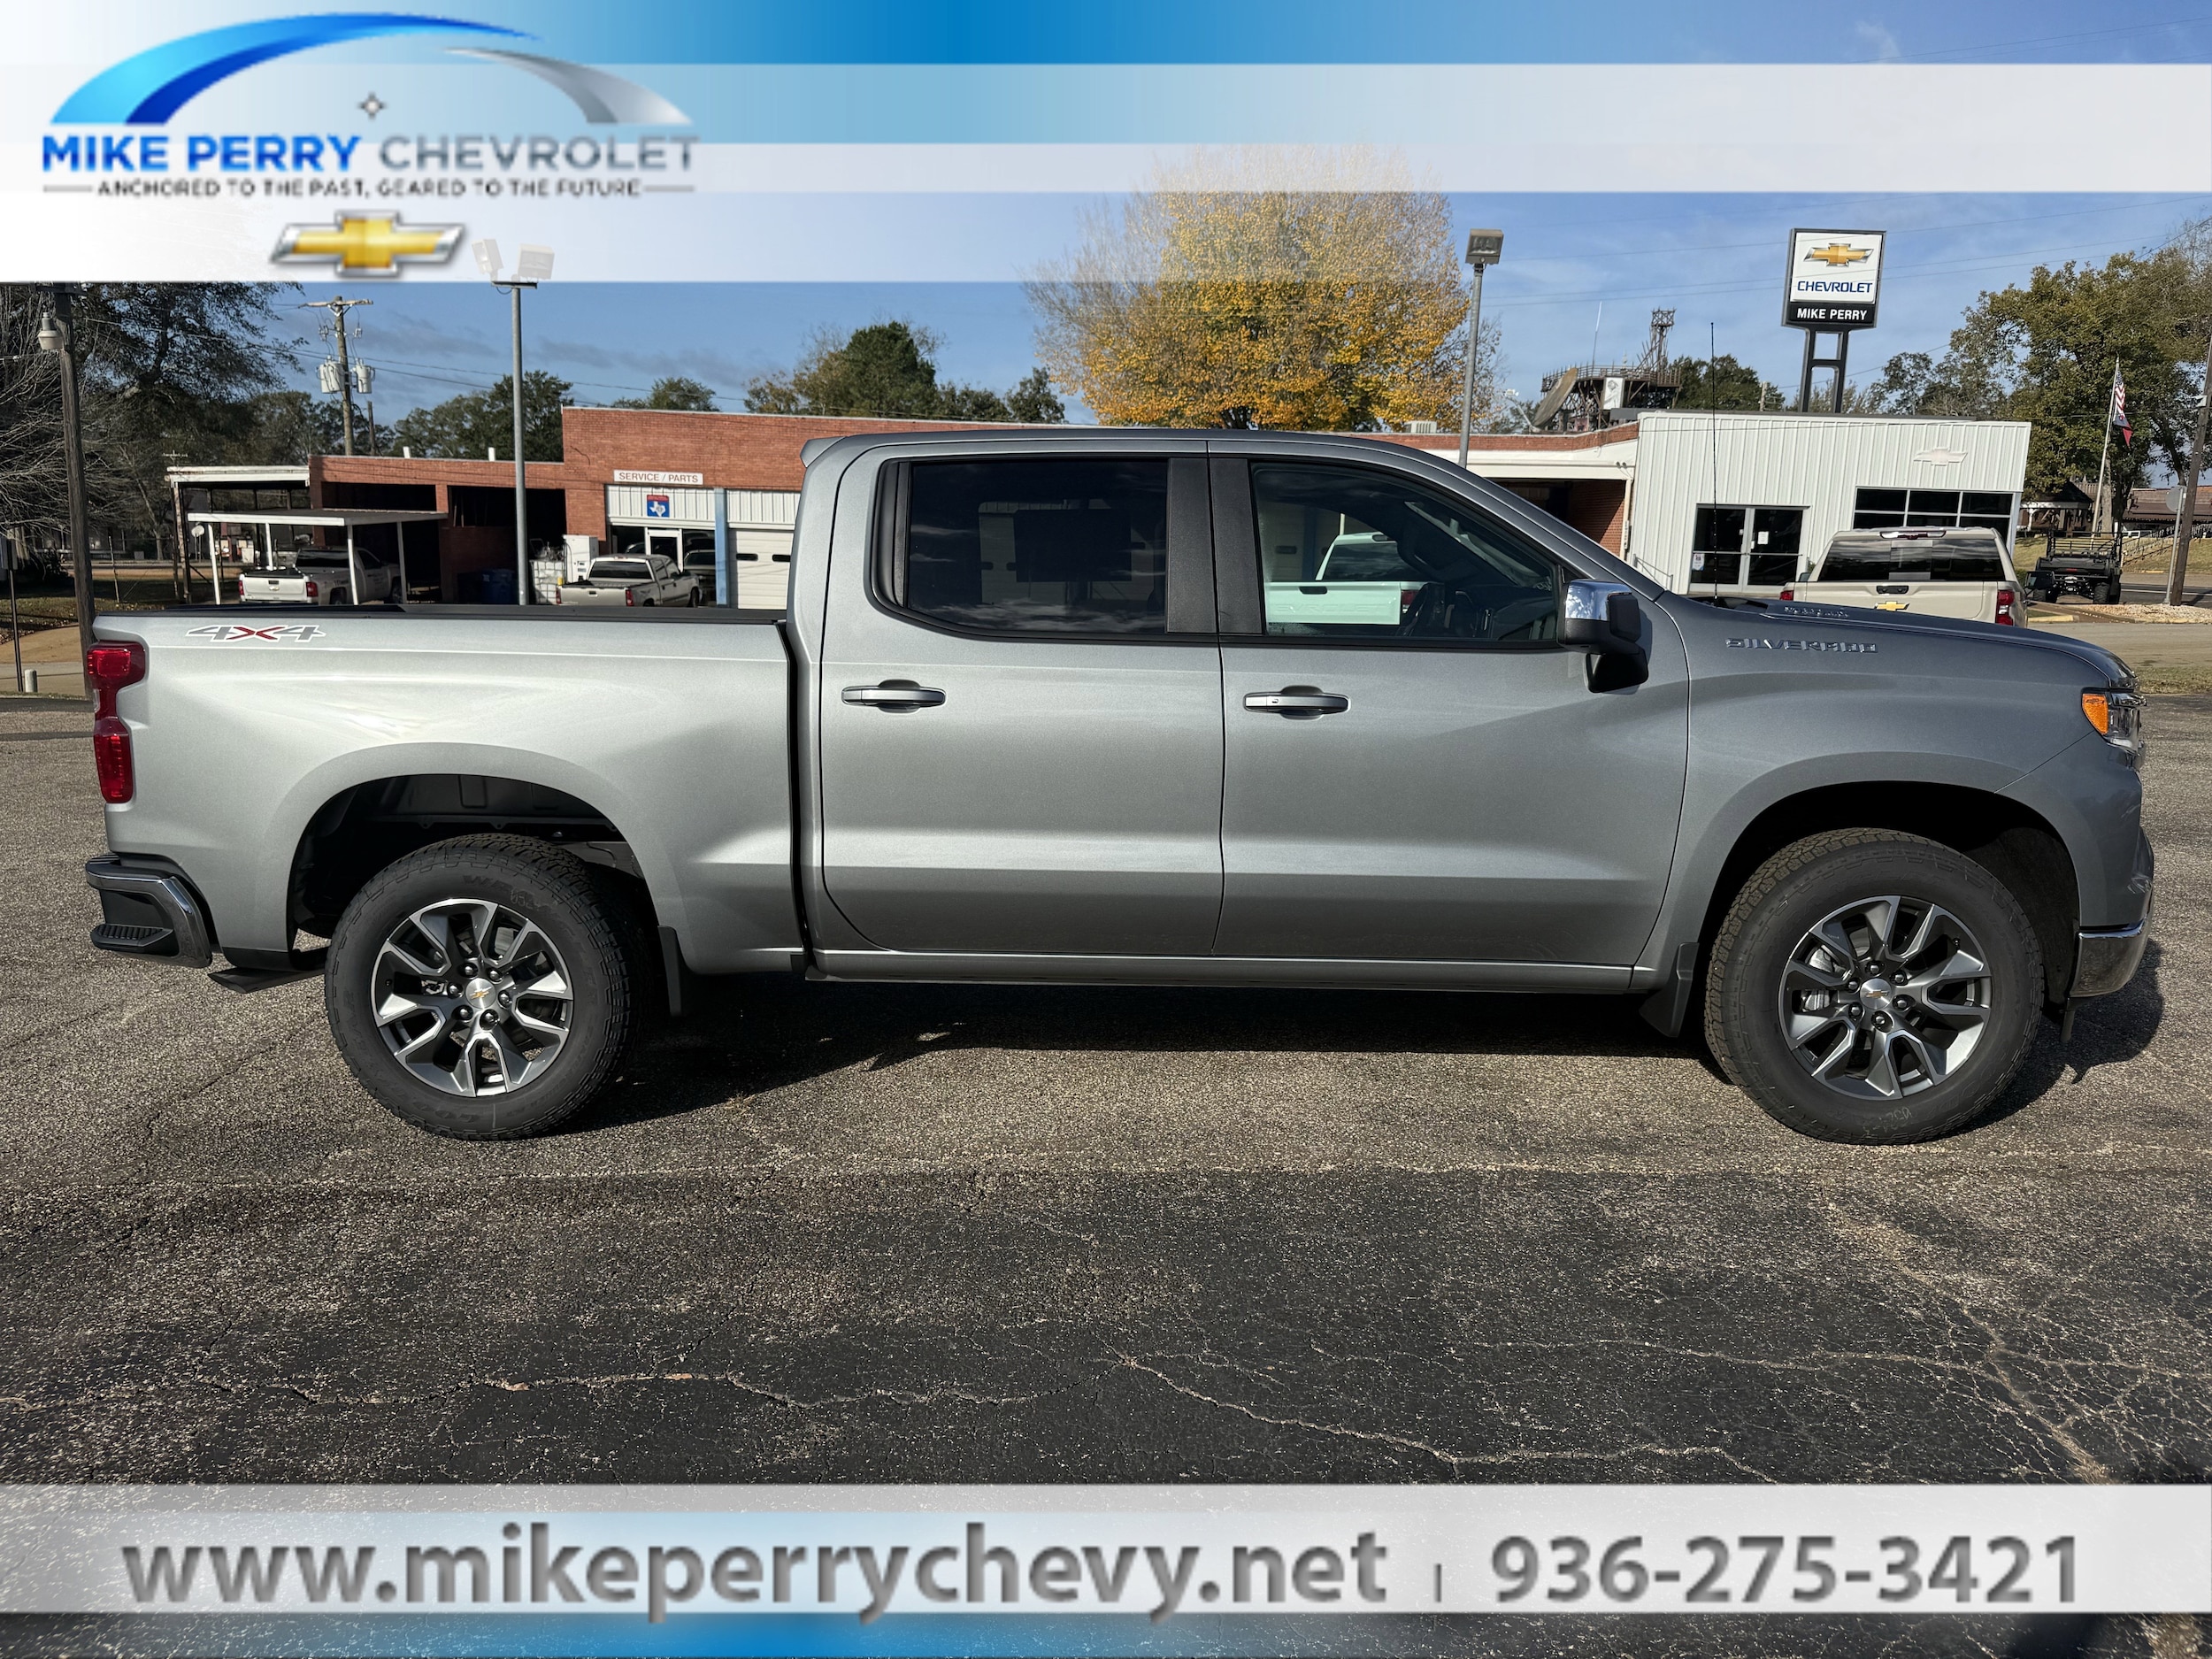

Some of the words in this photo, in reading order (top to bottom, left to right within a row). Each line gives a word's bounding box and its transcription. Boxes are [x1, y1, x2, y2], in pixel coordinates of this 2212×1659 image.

[1797, 280, 1873, 294] CHEVROLET
[1797, 307, 1827, 319] MIKE
[1829, 308, 1868, 320] PERRY
[618, 472, 660, 481] SERVICE
[668, 474, 699, 483] PARTS
[1725, 637, 1878, 654] SILVERADO
